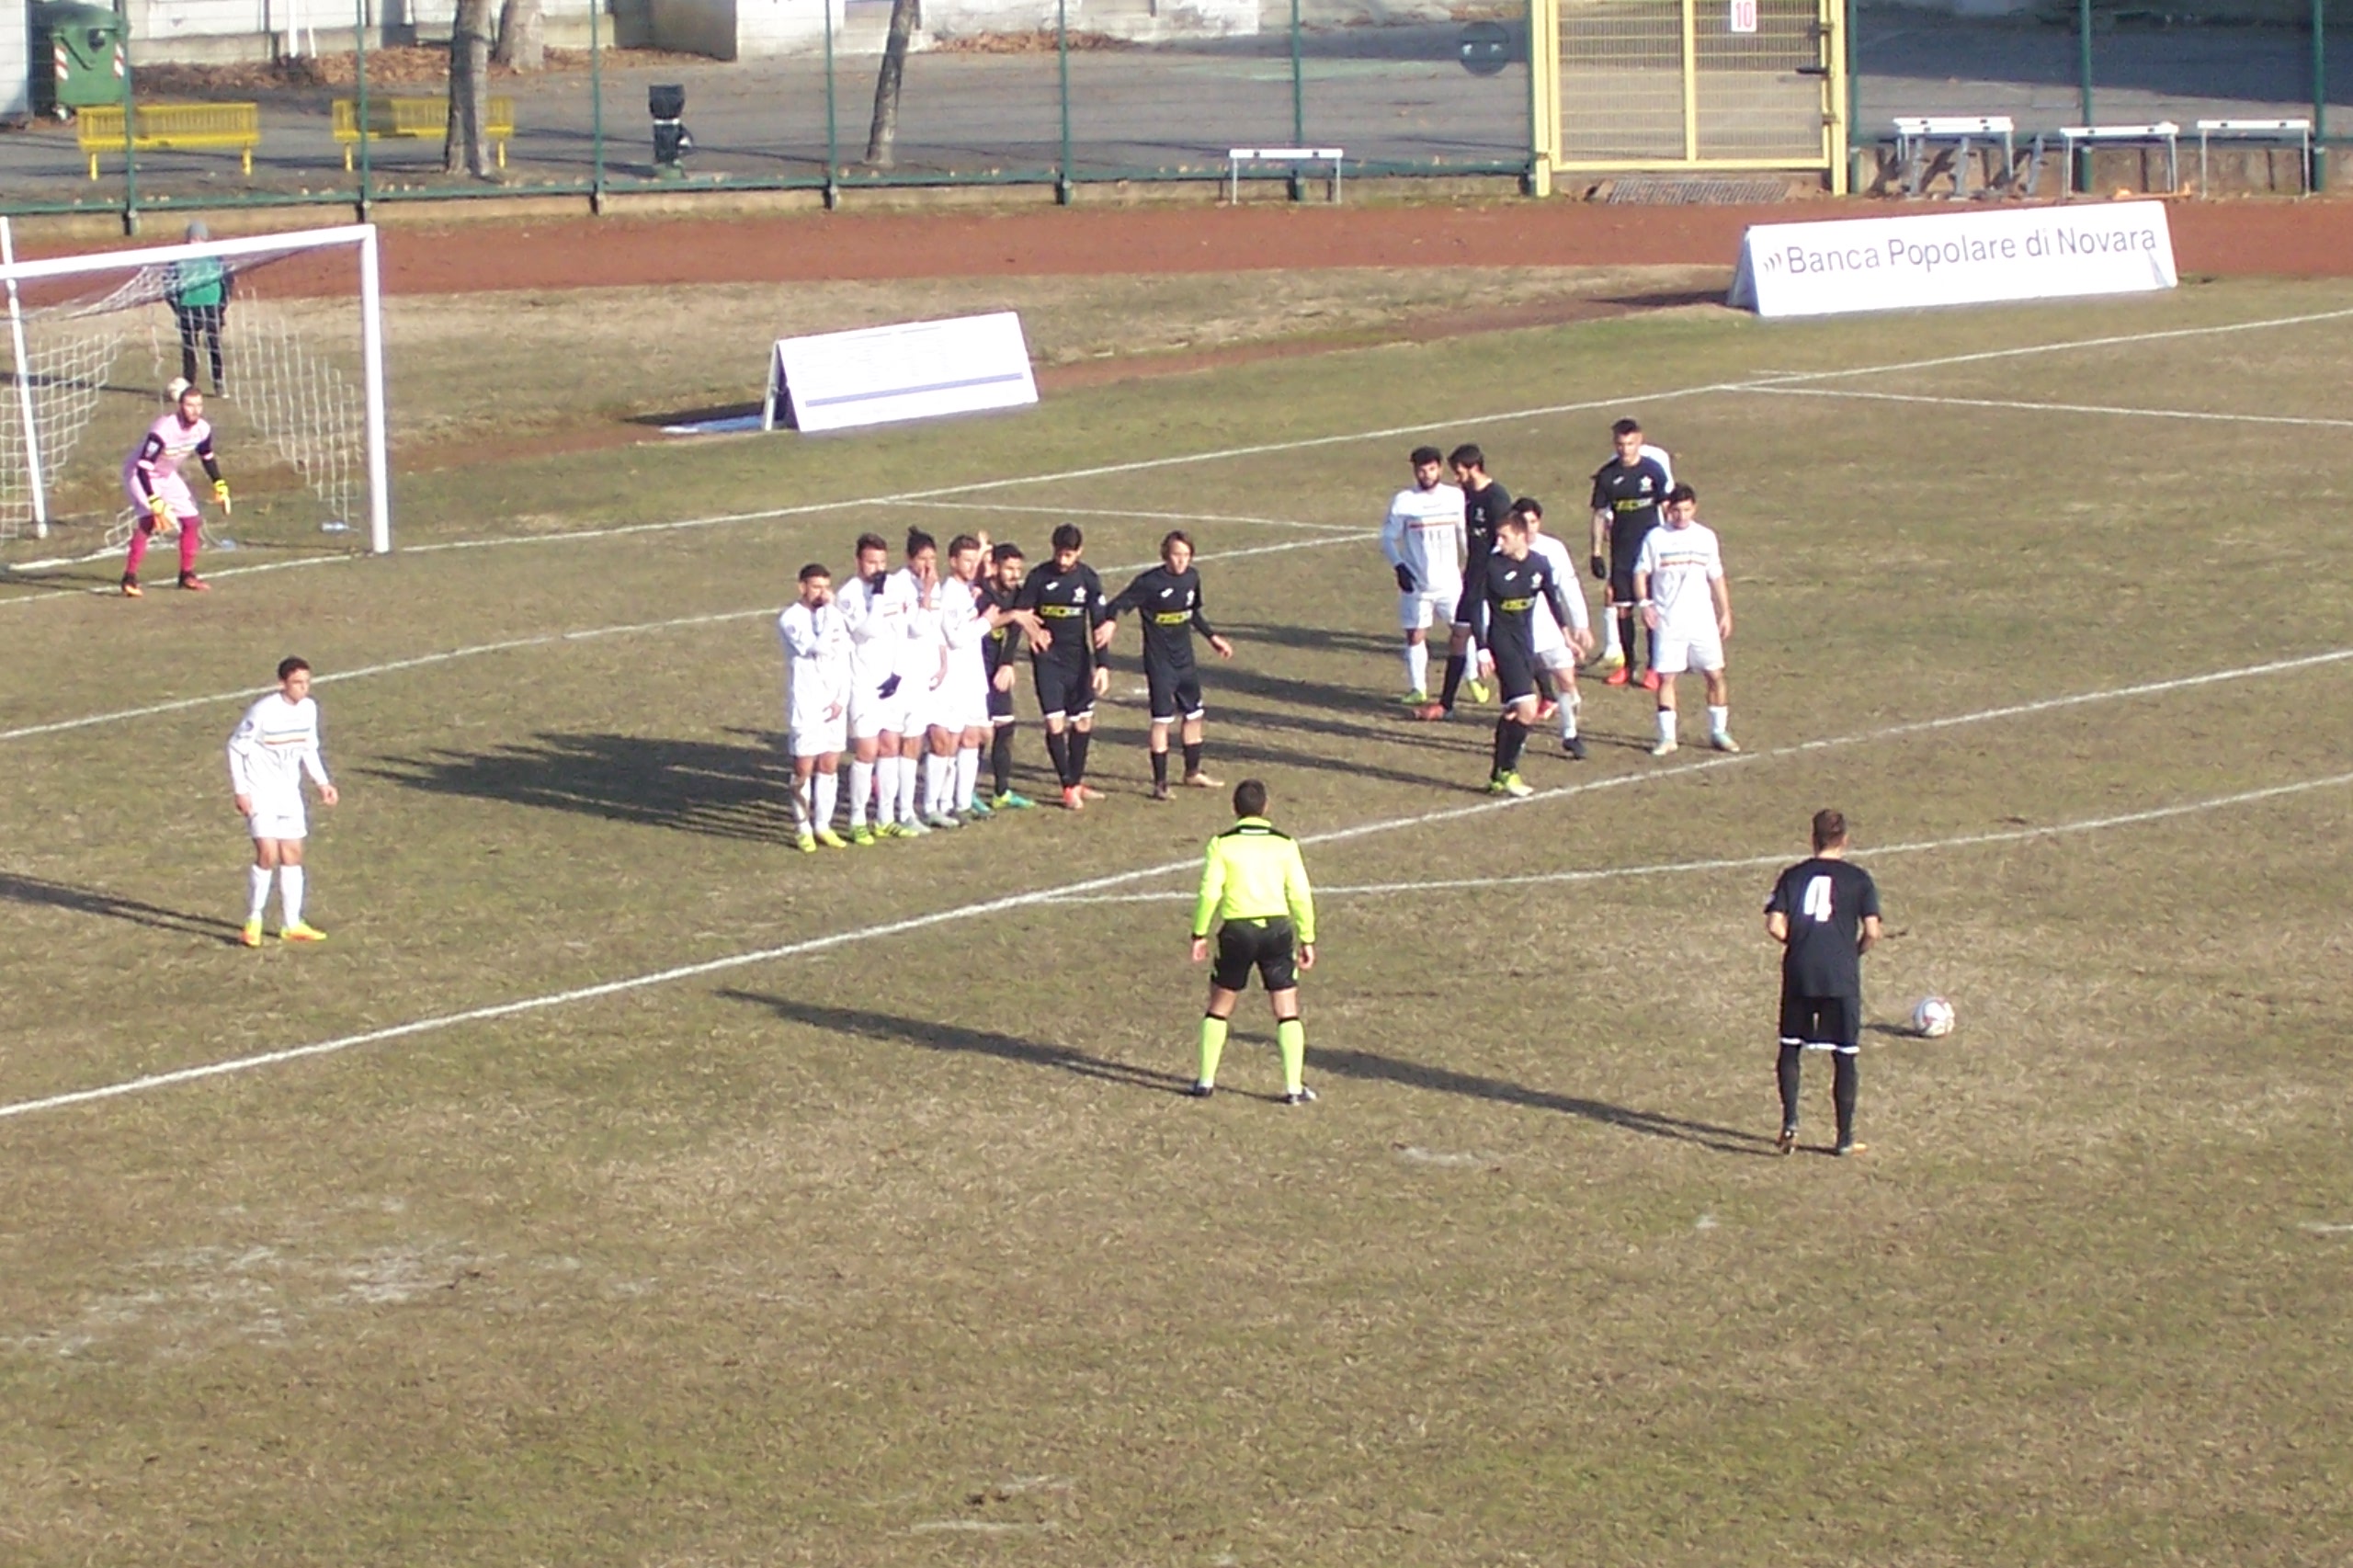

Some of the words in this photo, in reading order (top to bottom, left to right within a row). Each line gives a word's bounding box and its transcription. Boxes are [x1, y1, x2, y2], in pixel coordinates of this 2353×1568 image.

[1735, 2, 1753, 28] 10
[1787, 245, 1881, 274] Banca
[1888, 231, 2016, 272] Popolare
[2025, 227, 2051, 257] di
[2057, 228, 2156, 256] Novara
[1803, 875, 1832, 923] 4
